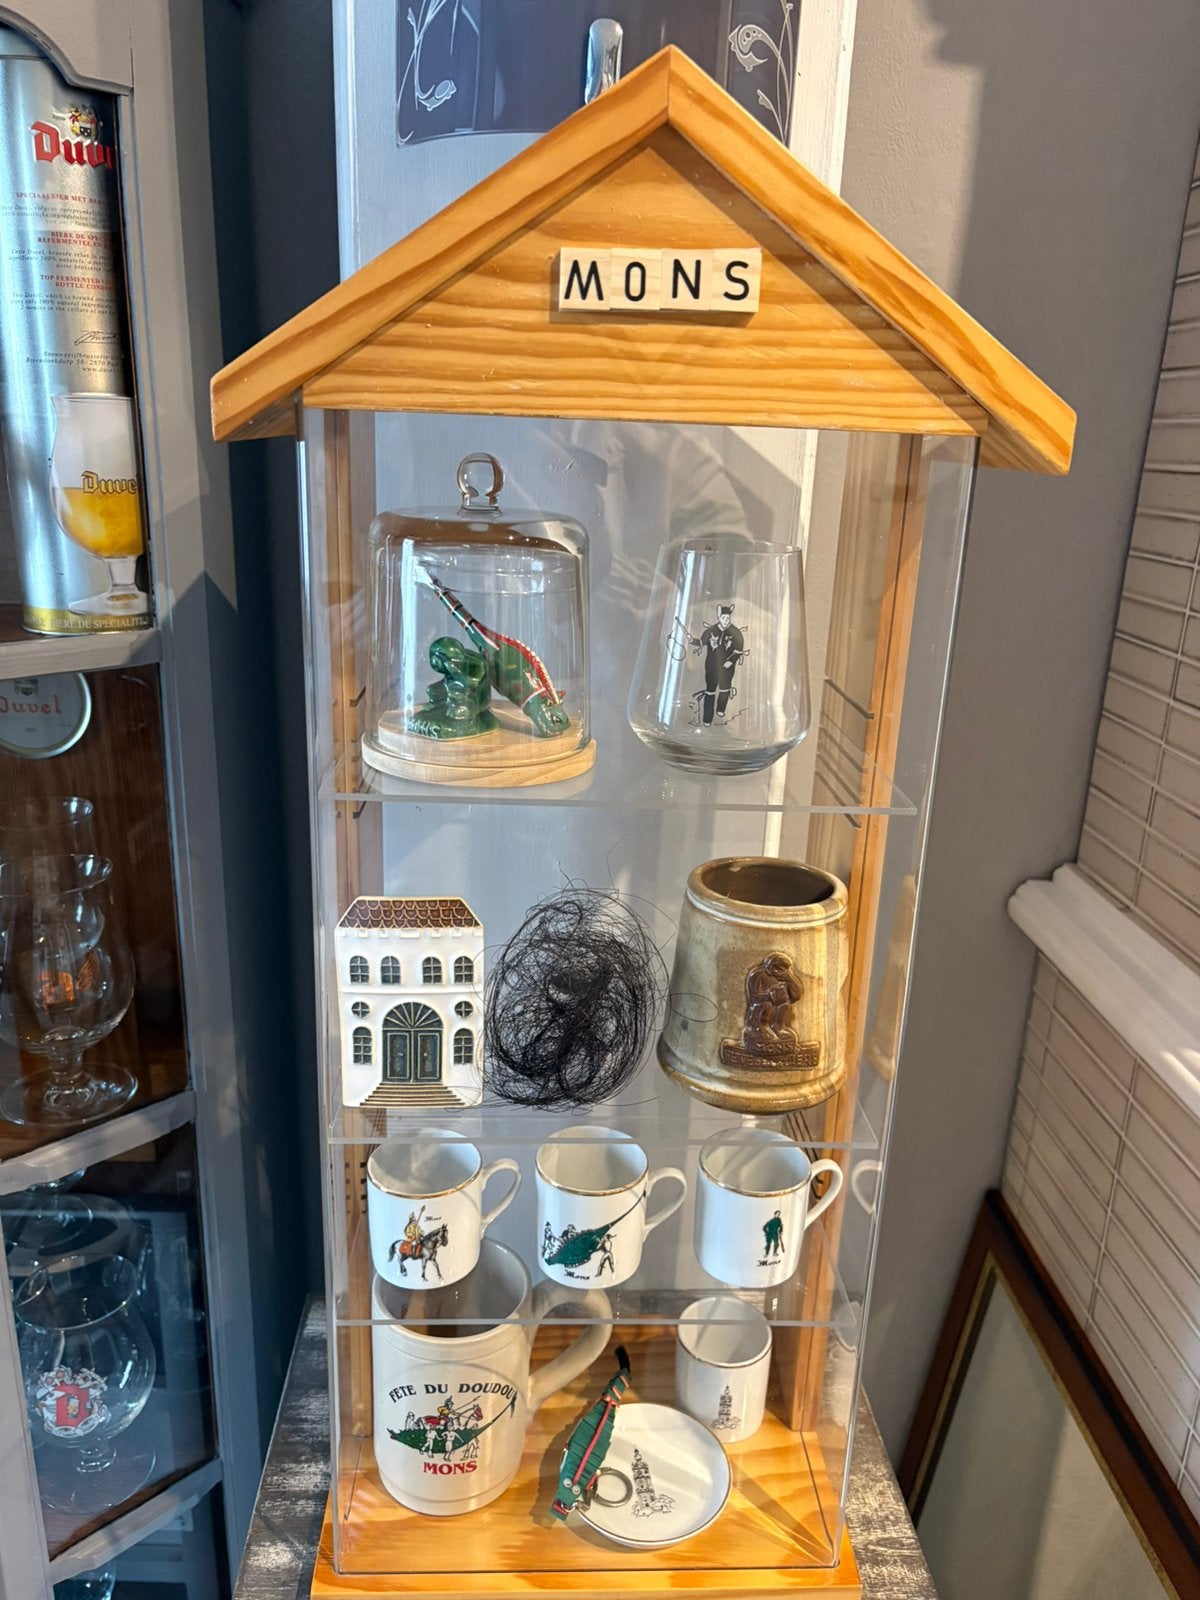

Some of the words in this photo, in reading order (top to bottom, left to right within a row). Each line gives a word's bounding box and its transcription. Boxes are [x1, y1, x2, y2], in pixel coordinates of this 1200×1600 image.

[564, 259, 750, 301] MONS
[78, 619, 92, 630] DE
[424, 1383, 448, 1394] DU
[458, 1382, 517, 1400] DOUDOU
[423, 1460, 478, 1475] MONS
